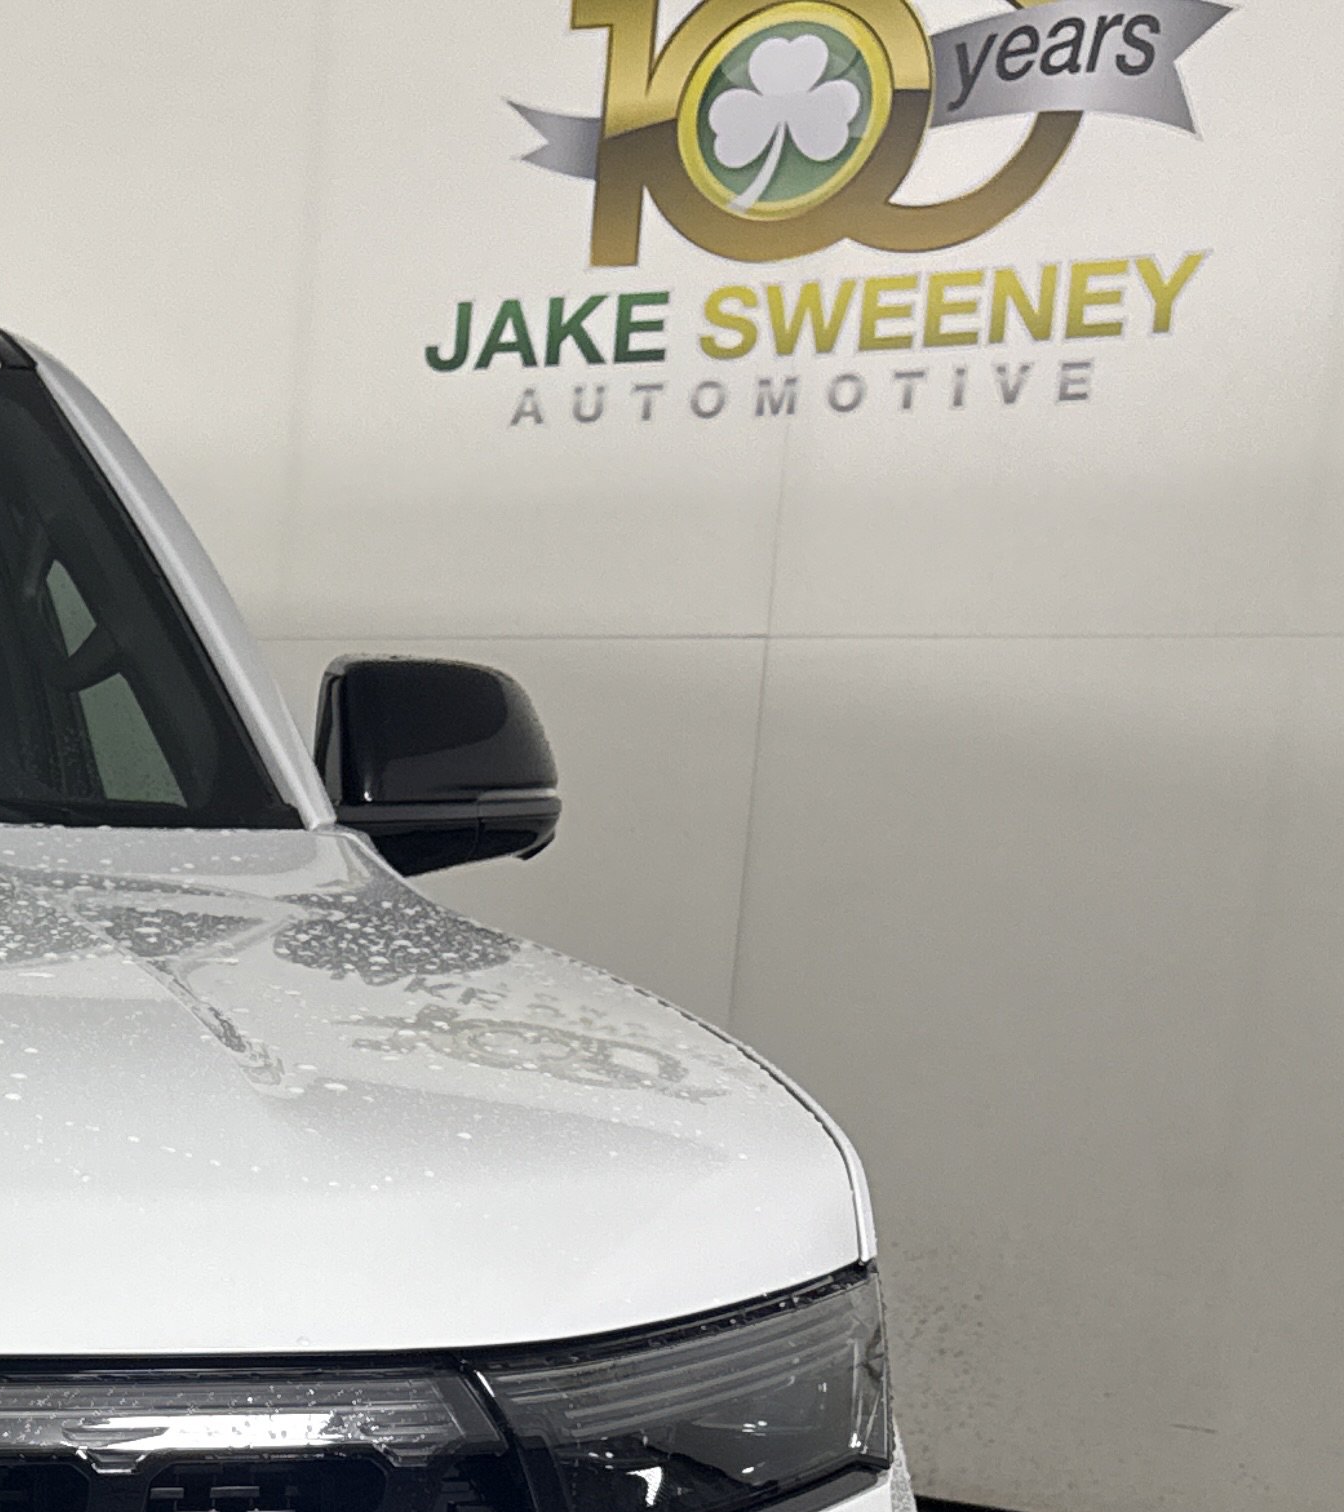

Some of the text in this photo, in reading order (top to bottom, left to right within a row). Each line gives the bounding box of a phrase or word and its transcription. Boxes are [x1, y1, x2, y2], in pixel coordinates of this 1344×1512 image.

[948, 6, 1162, 113] years
[424, 249, 1214, 374] JAKE SWEENEY
[510, 359, 1095, 428] AUTOMOTIVE
